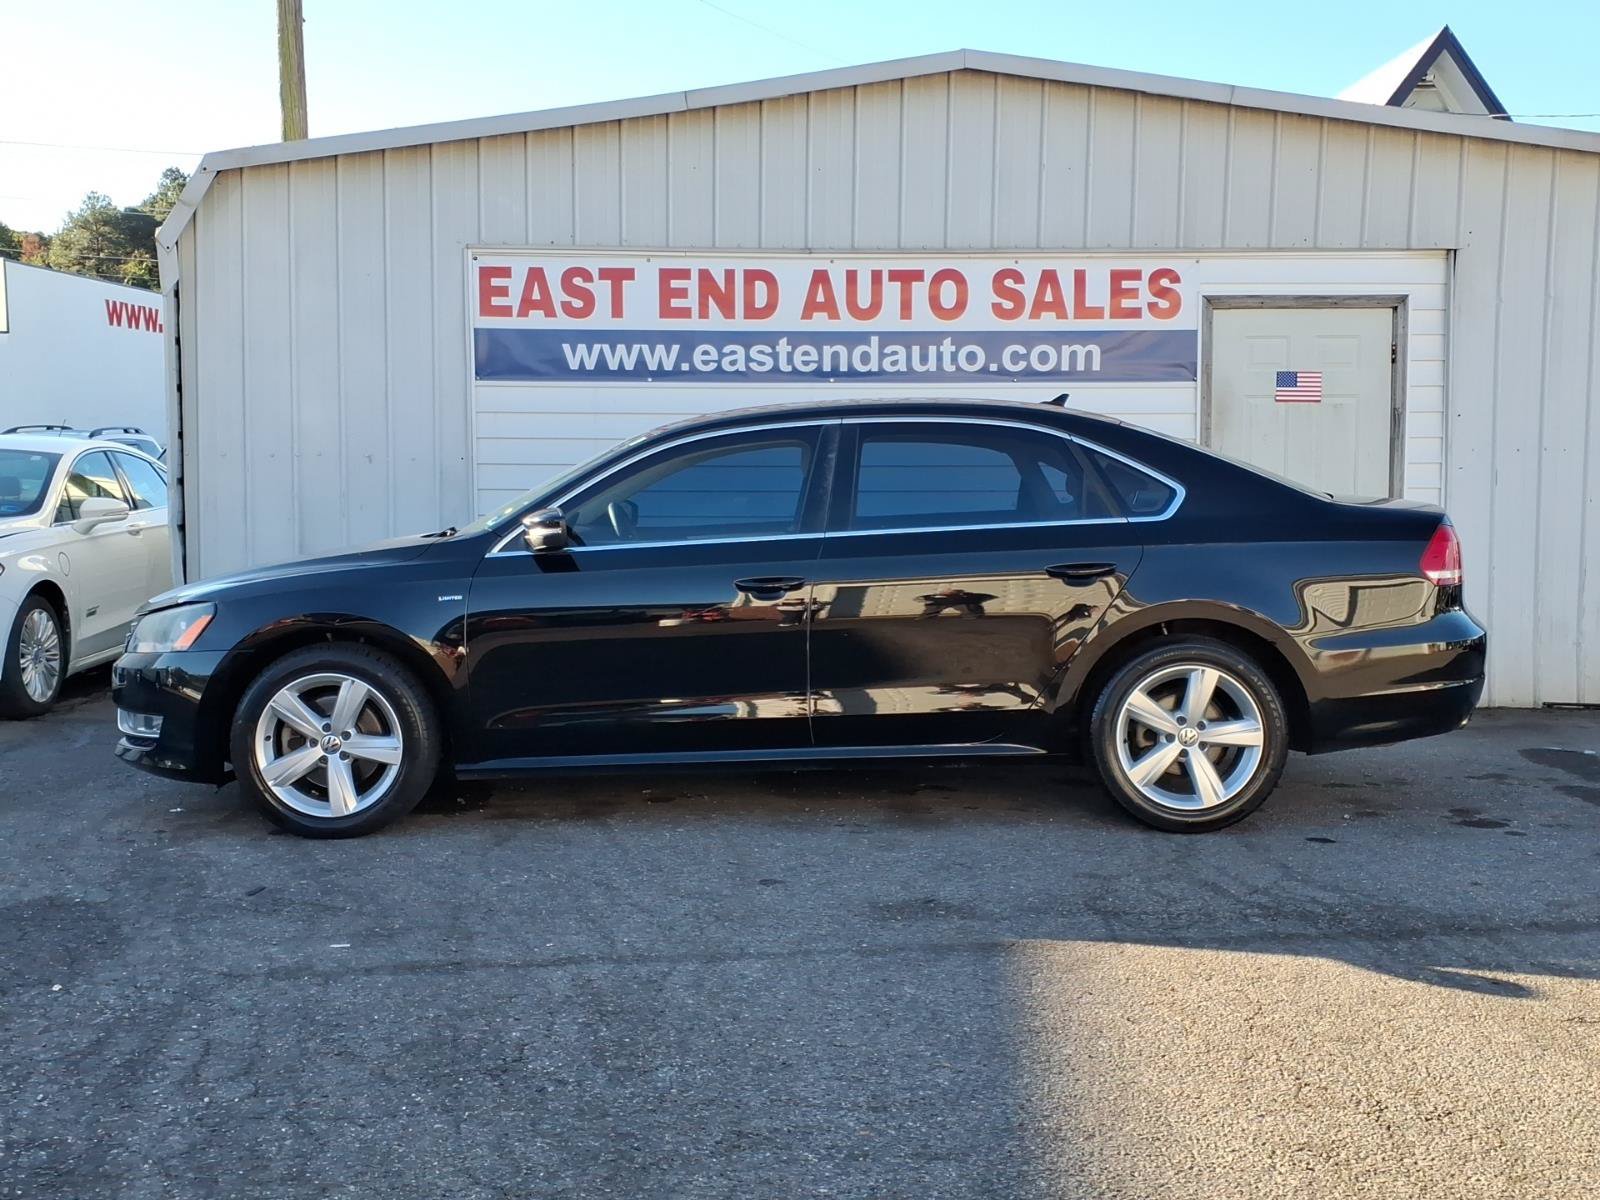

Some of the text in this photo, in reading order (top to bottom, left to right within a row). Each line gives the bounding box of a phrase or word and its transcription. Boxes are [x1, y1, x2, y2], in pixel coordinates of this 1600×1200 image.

[478, 266, 1184, 321] EAST END AUTO SALES
[561, 336, 1101, 372] www.eastendauto.com
